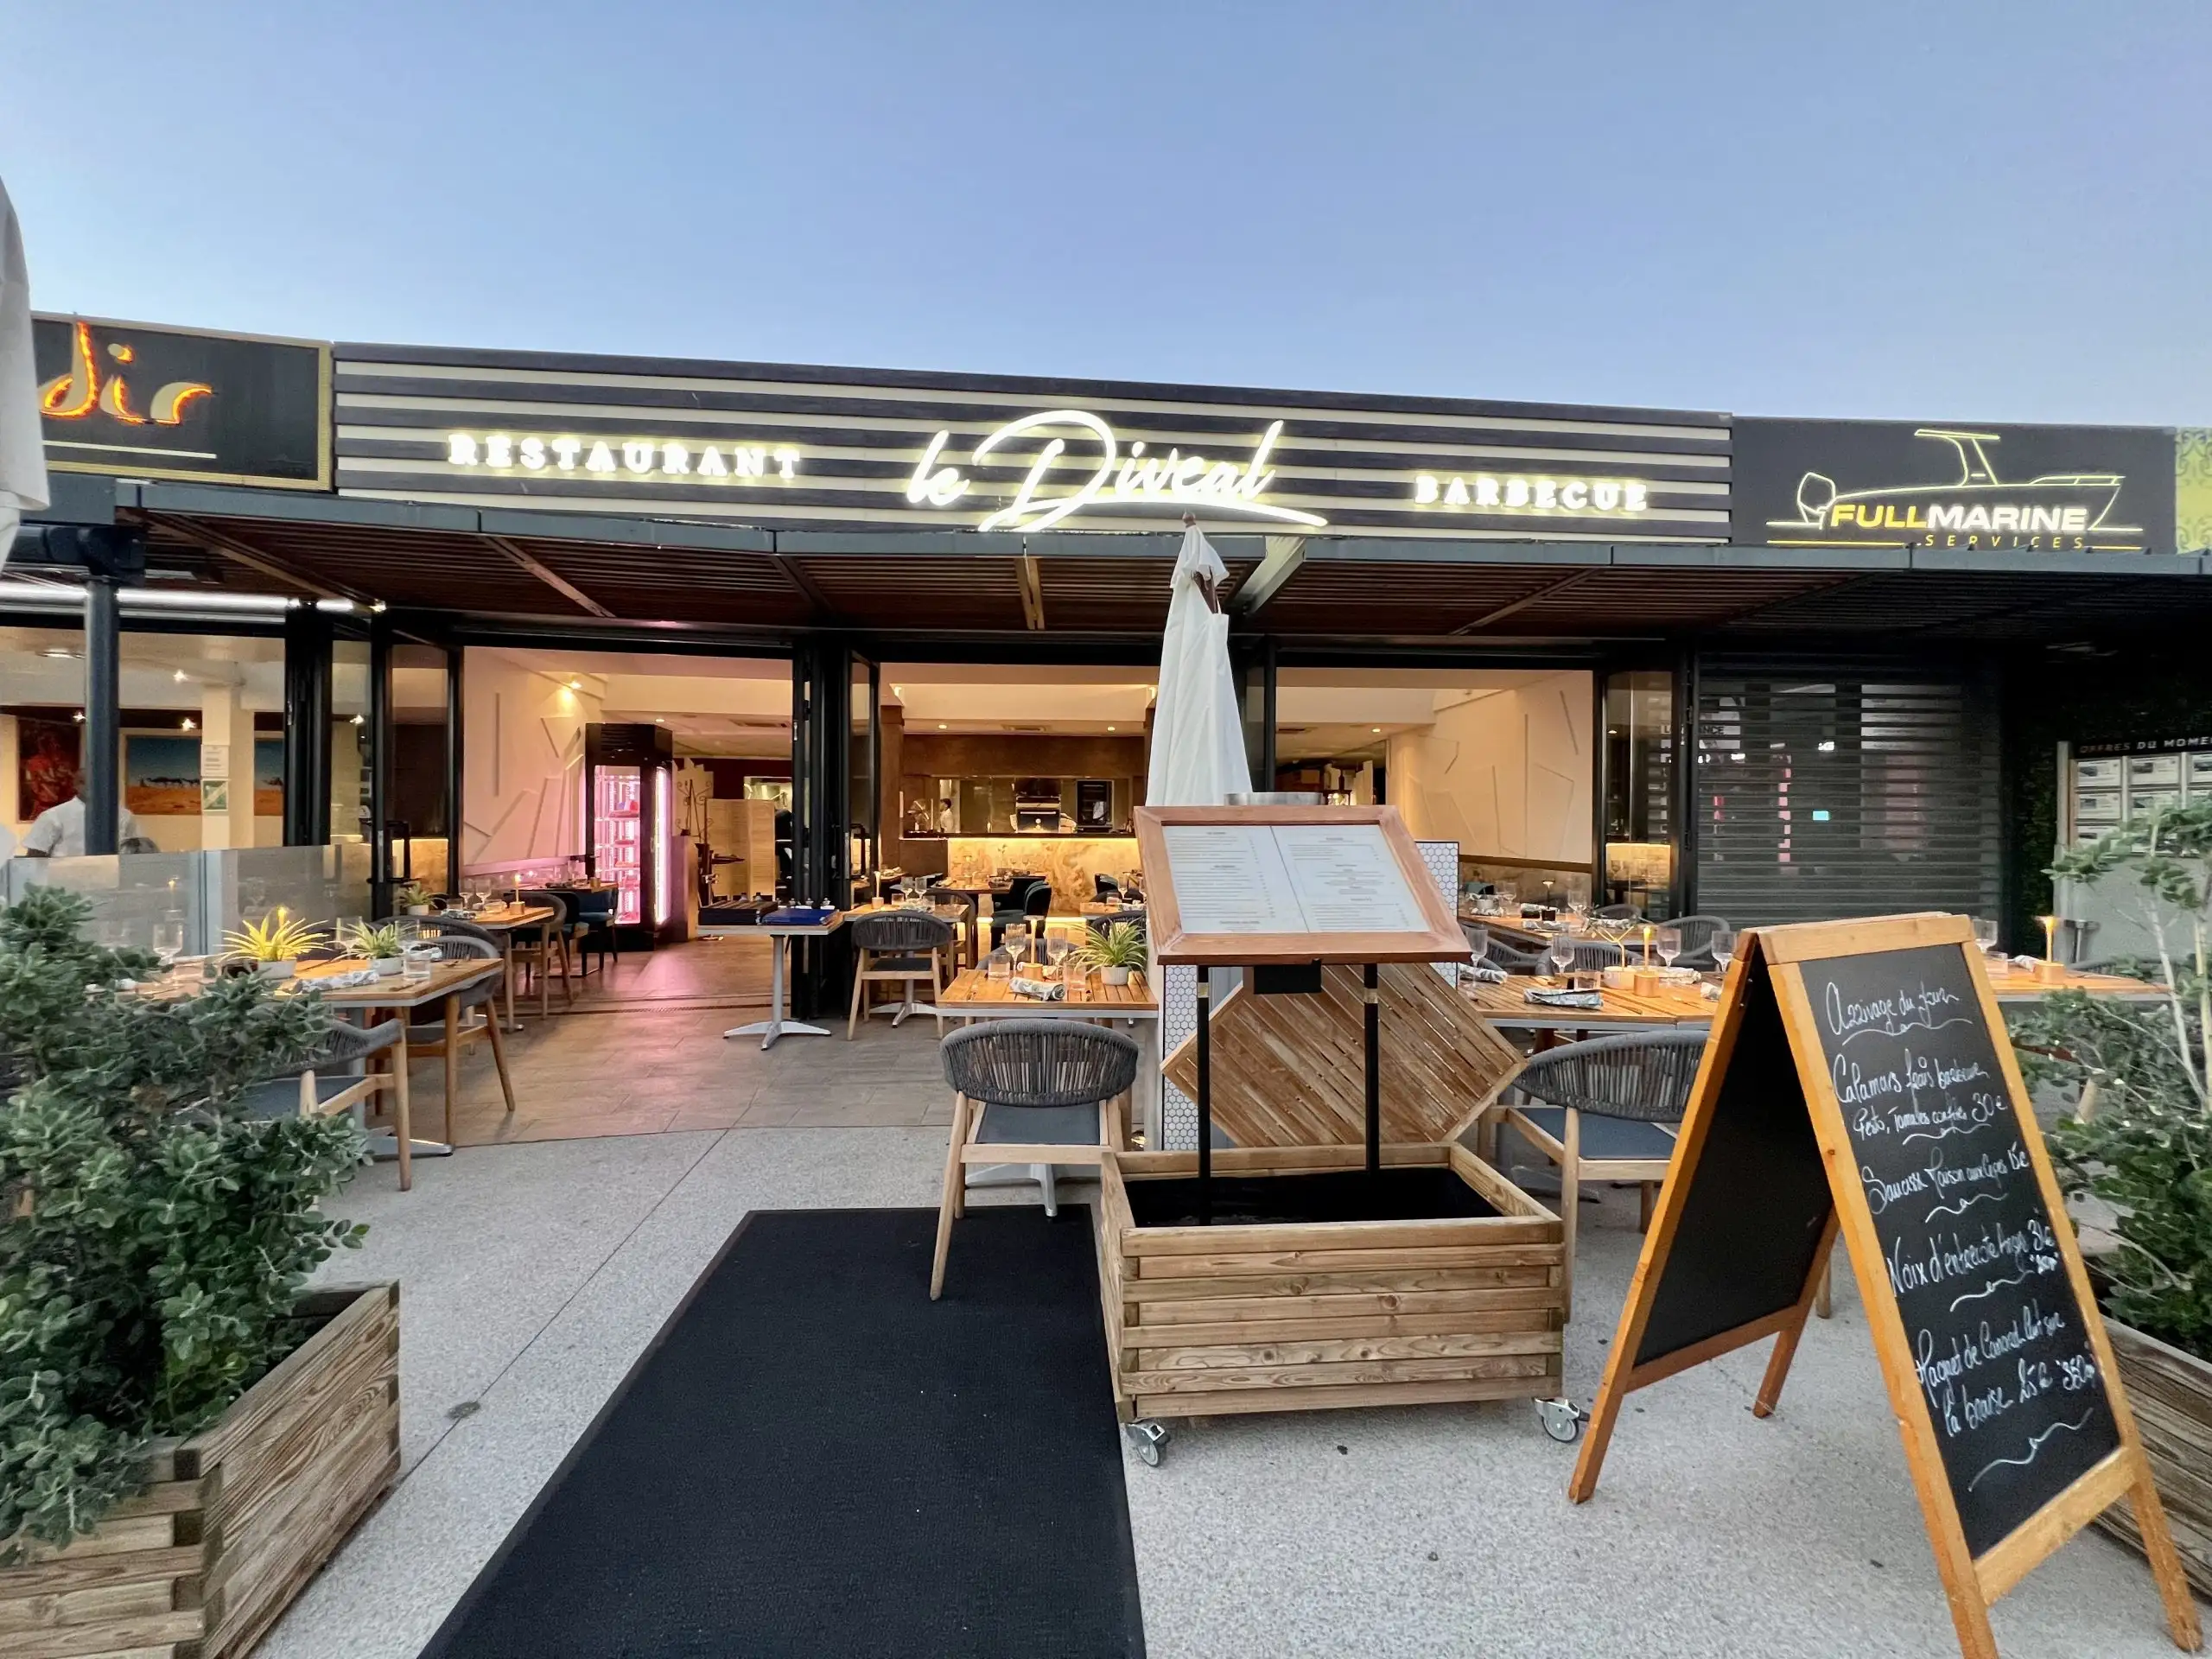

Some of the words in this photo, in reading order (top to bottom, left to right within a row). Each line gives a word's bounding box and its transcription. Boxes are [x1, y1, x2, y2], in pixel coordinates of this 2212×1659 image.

[447, 432, 801, 479] RESTAURANT
[1414, 475, 1649, 512] BARBECUE
[1924, 534, 2084, 550] SERVICES
[2164, 736, 2212, 748] MOME
